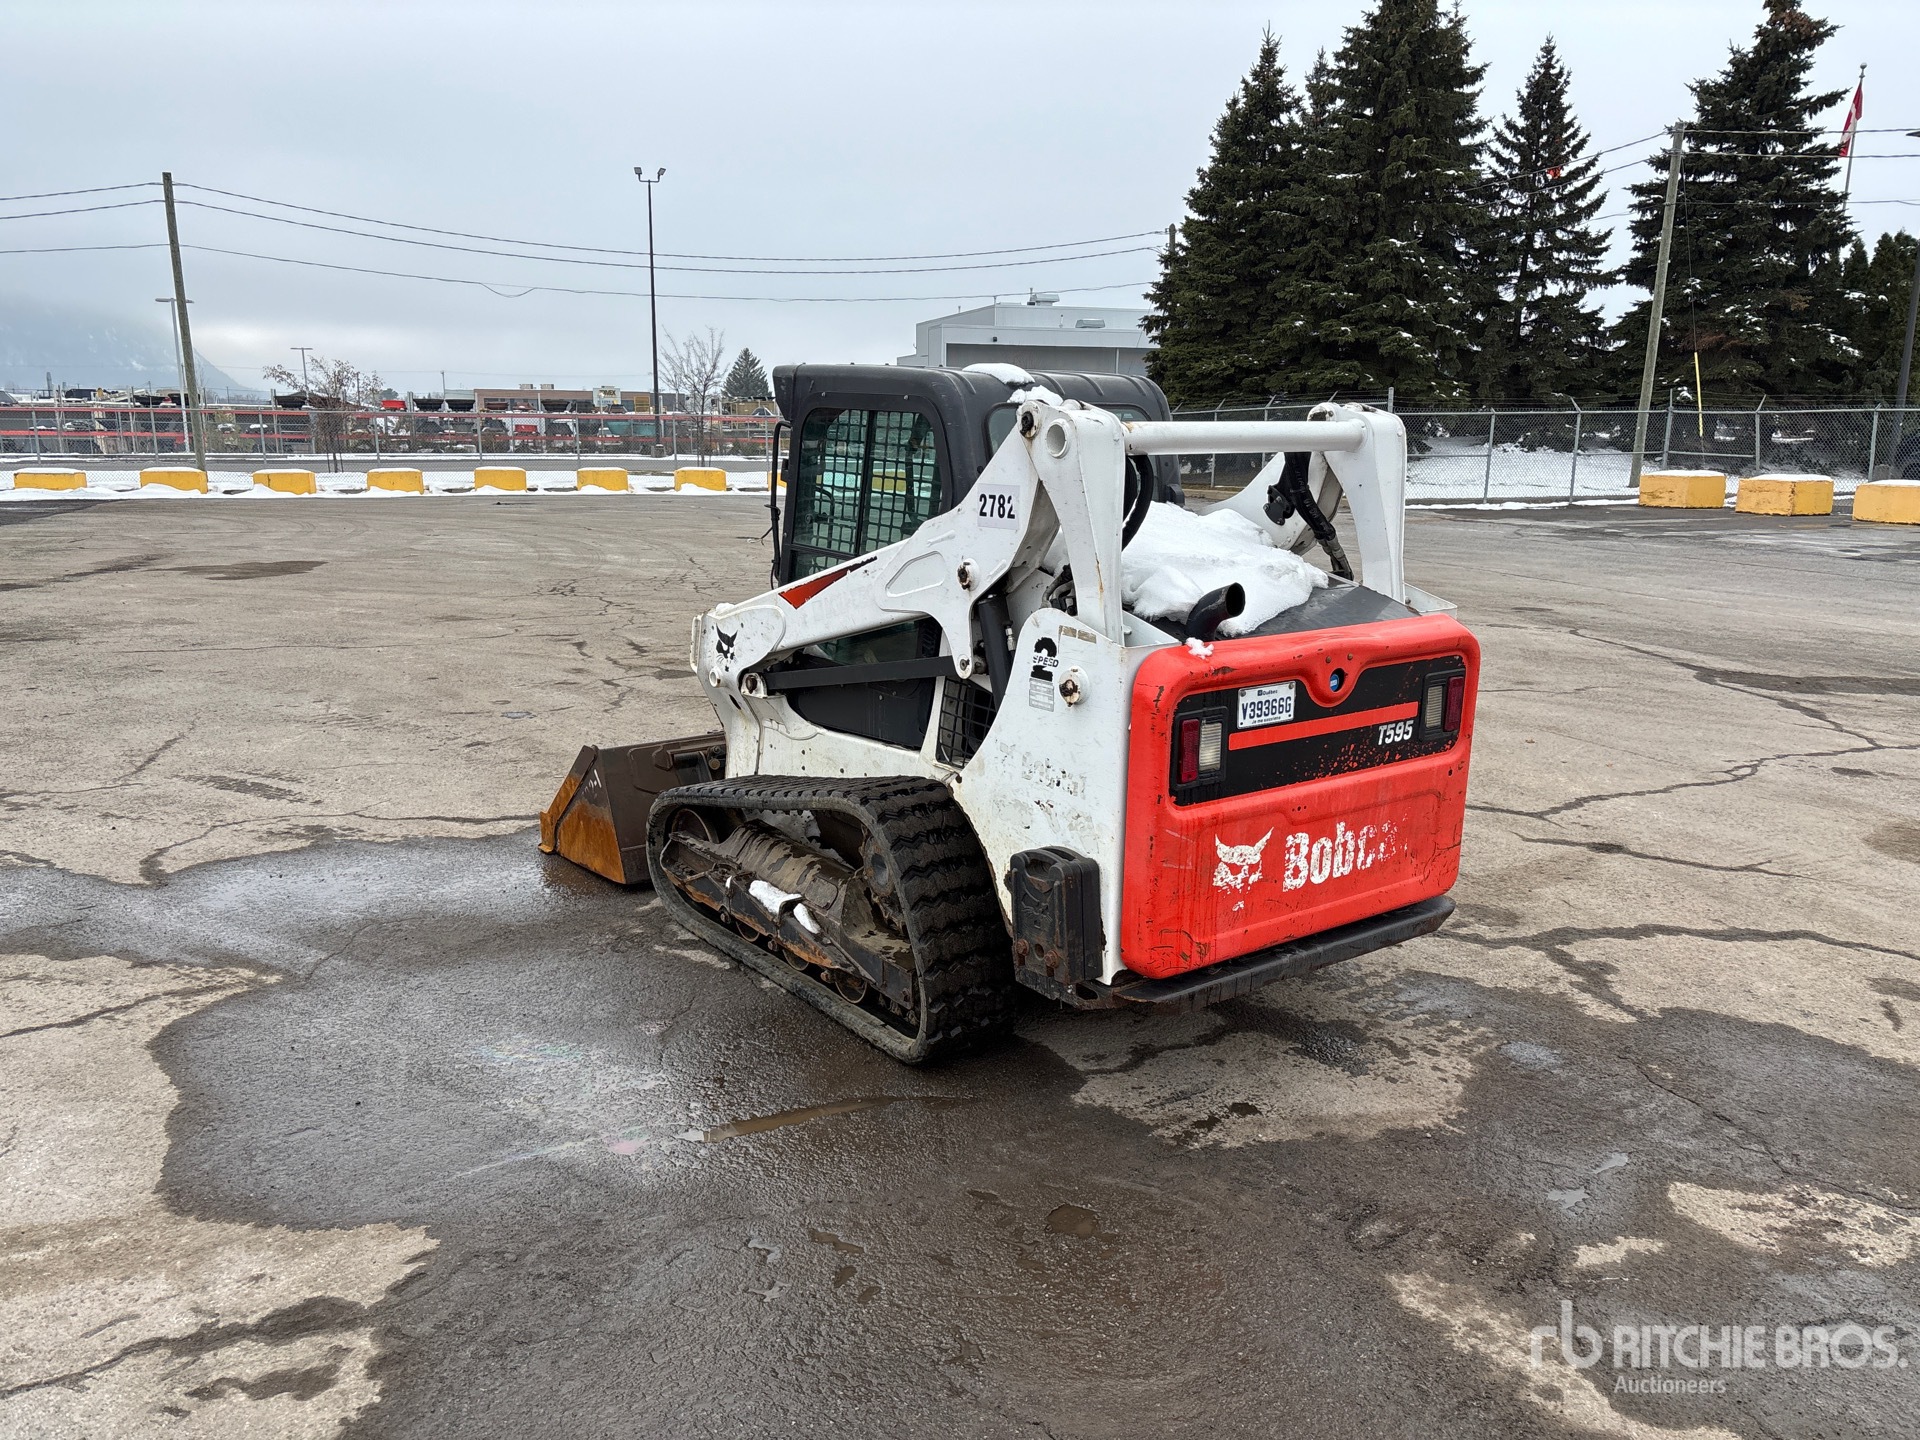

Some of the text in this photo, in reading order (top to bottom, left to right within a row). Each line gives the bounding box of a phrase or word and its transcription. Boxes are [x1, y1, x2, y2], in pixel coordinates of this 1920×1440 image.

[979, 493, 1016, 519] 2782
[1241, 696, 1292, 720] V39366G
[1378, 720, 1414, 745] T595
